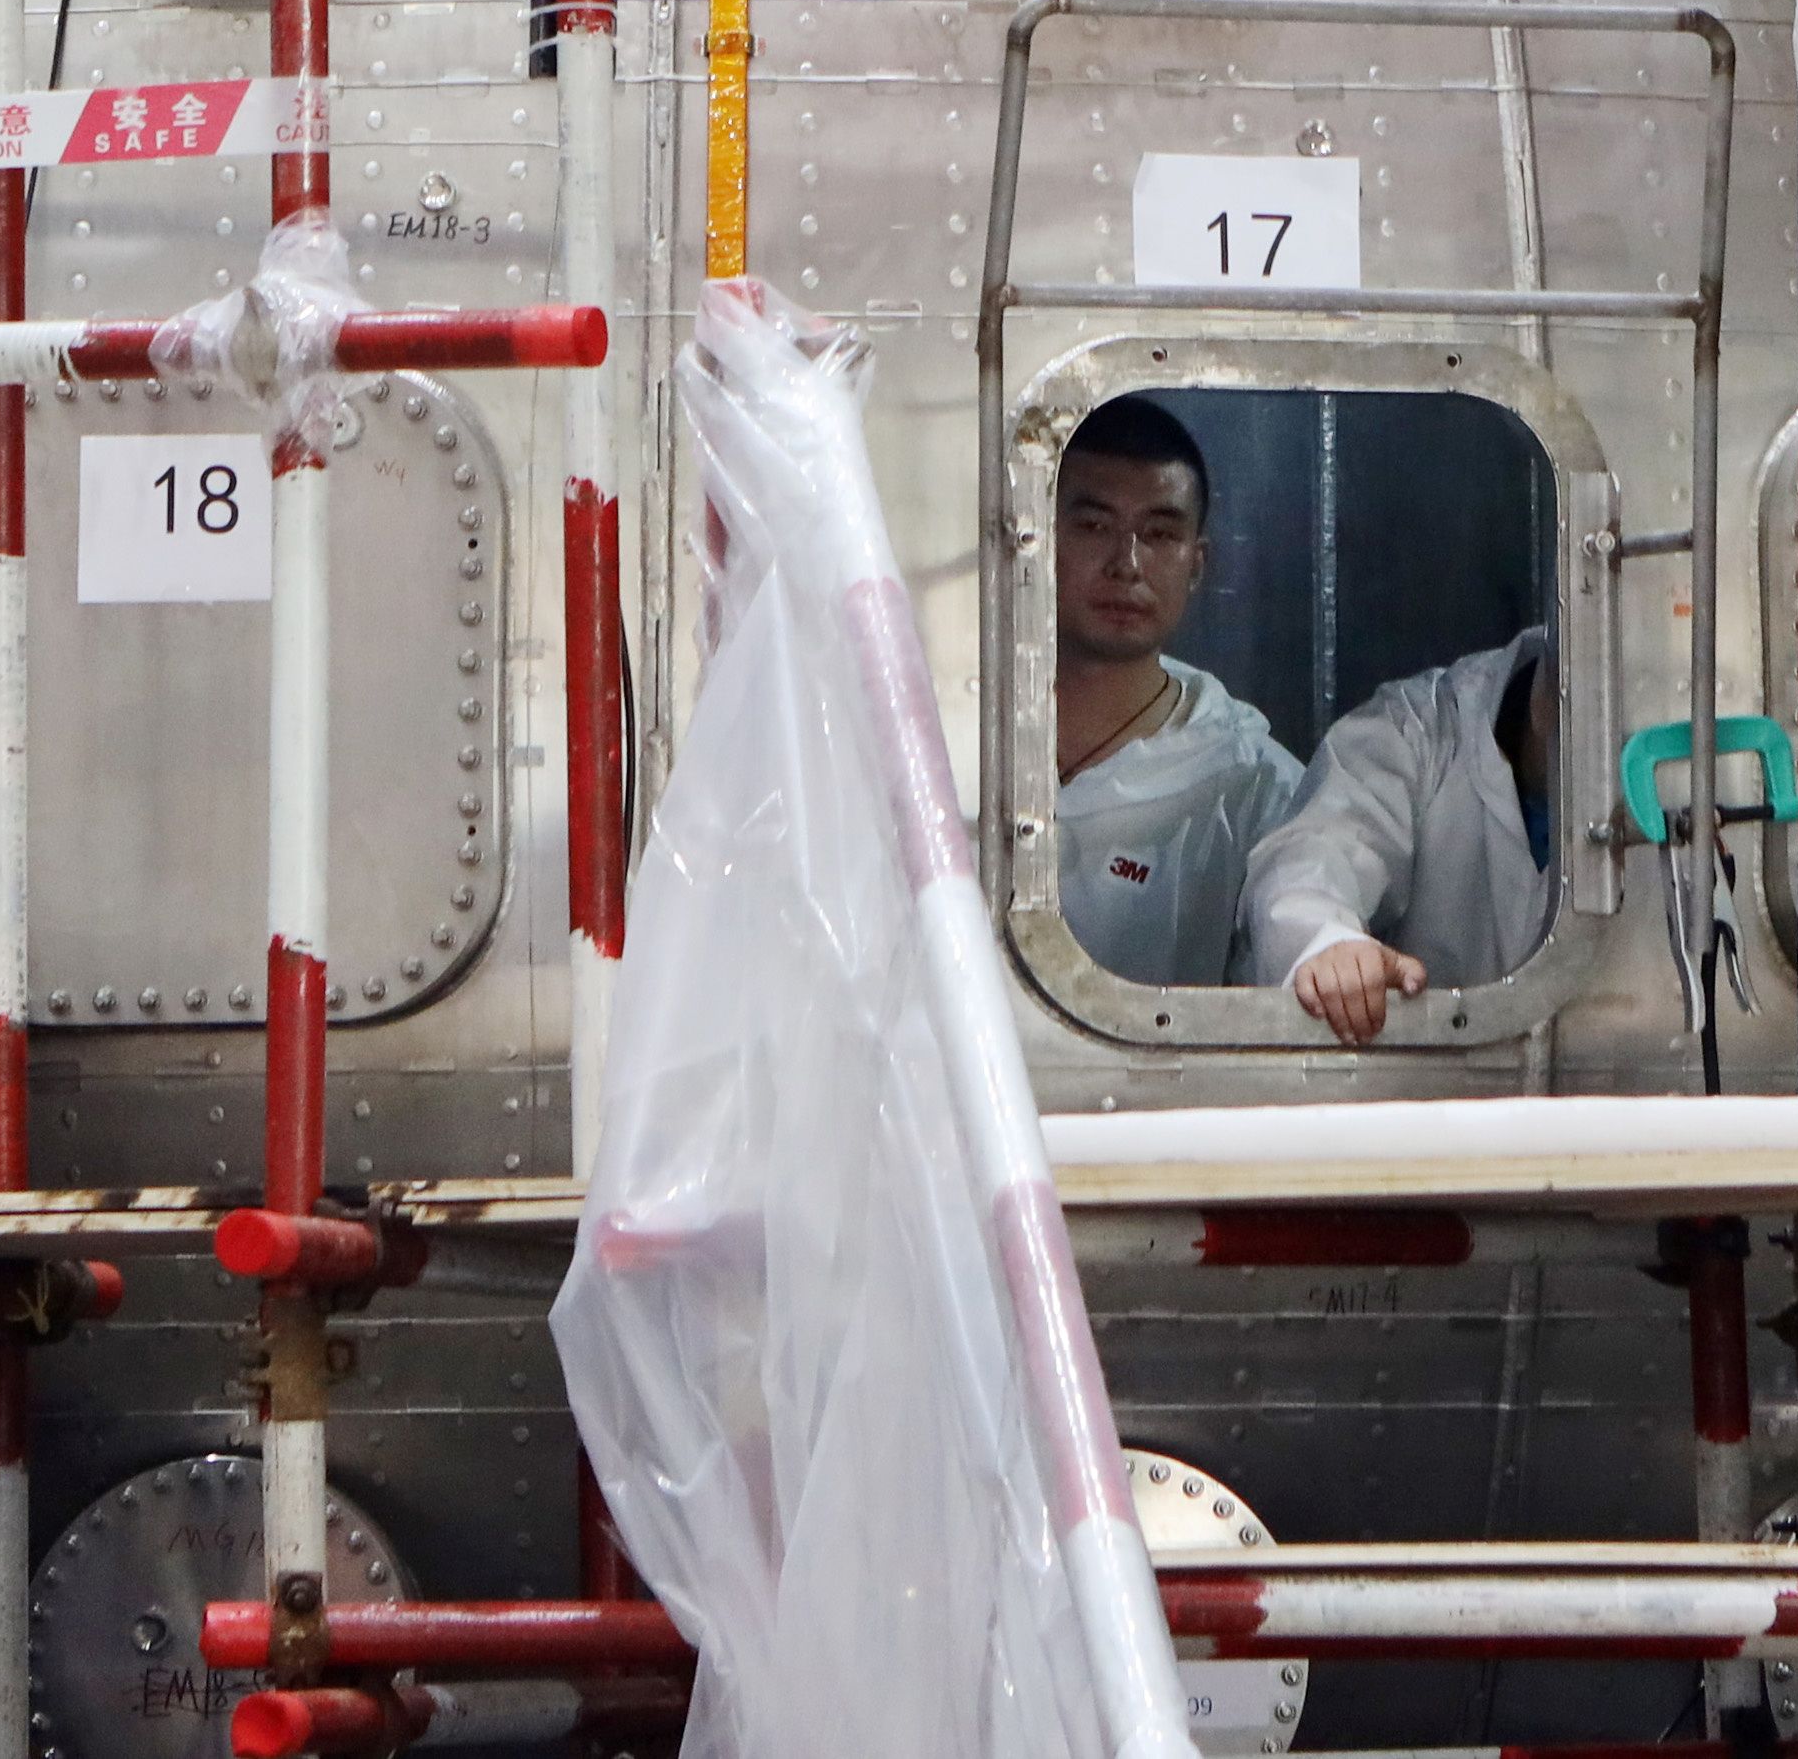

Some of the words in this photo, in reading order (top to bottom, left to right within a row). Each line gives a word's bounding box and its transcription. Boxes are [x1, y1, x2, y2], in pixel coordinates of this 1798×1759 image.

[112, 93, 208, 131] 安全
[94, 128, 198, 154] SAFE
[387, 211, 491, 245] EM18-3
[1206, 211, 1294, 277] 17
[154, 464, 239, 534] 18
[1110, 855, 1151, 884] 3M
